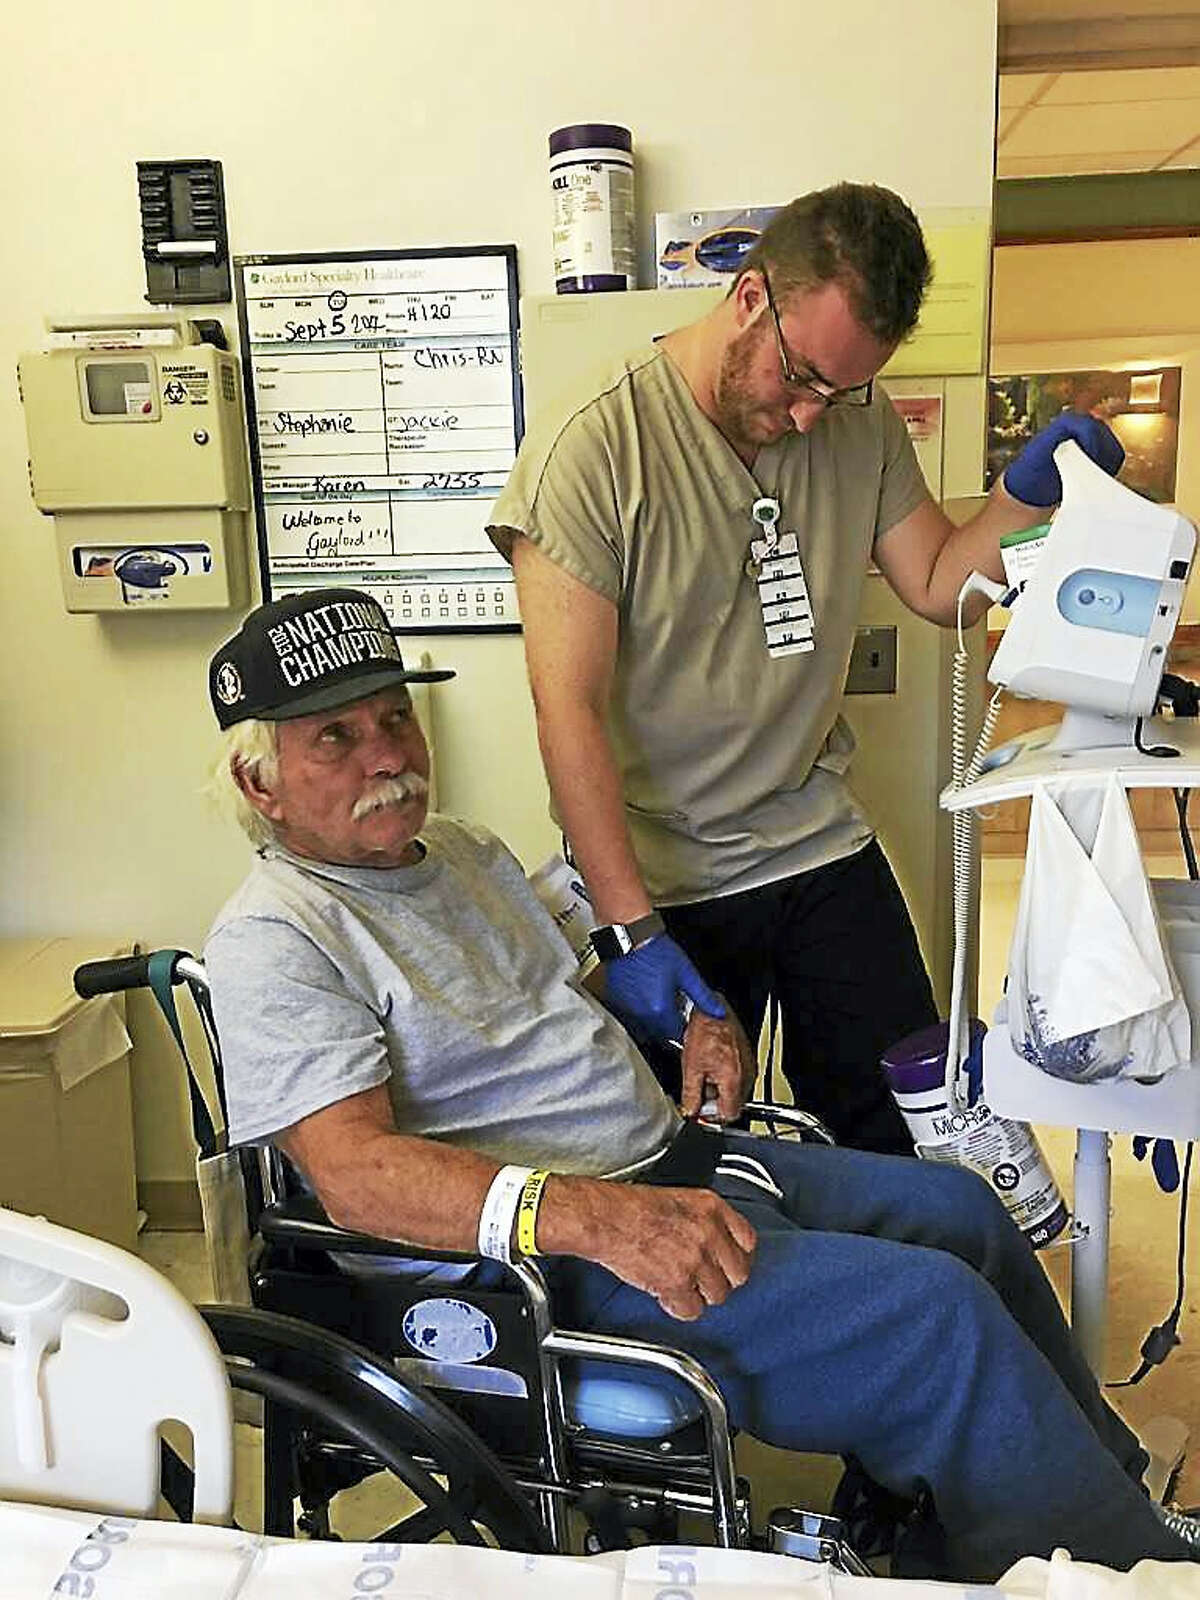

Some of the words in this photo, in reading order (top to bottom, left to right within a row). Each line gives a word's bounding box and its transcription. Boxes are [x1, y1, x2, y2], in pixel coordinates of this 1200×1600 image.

[285, 317, 327, 342] Sept
[330, 314, 346, 335] 5
[273, 411, 355, 438] Stephanie
[311, 474, 366, 494] Karen
[283, 602, 391, 649] NATION
[280, 629, 400, 687] CHAMPIO
[522, 1178, 541, 1212] RISK
